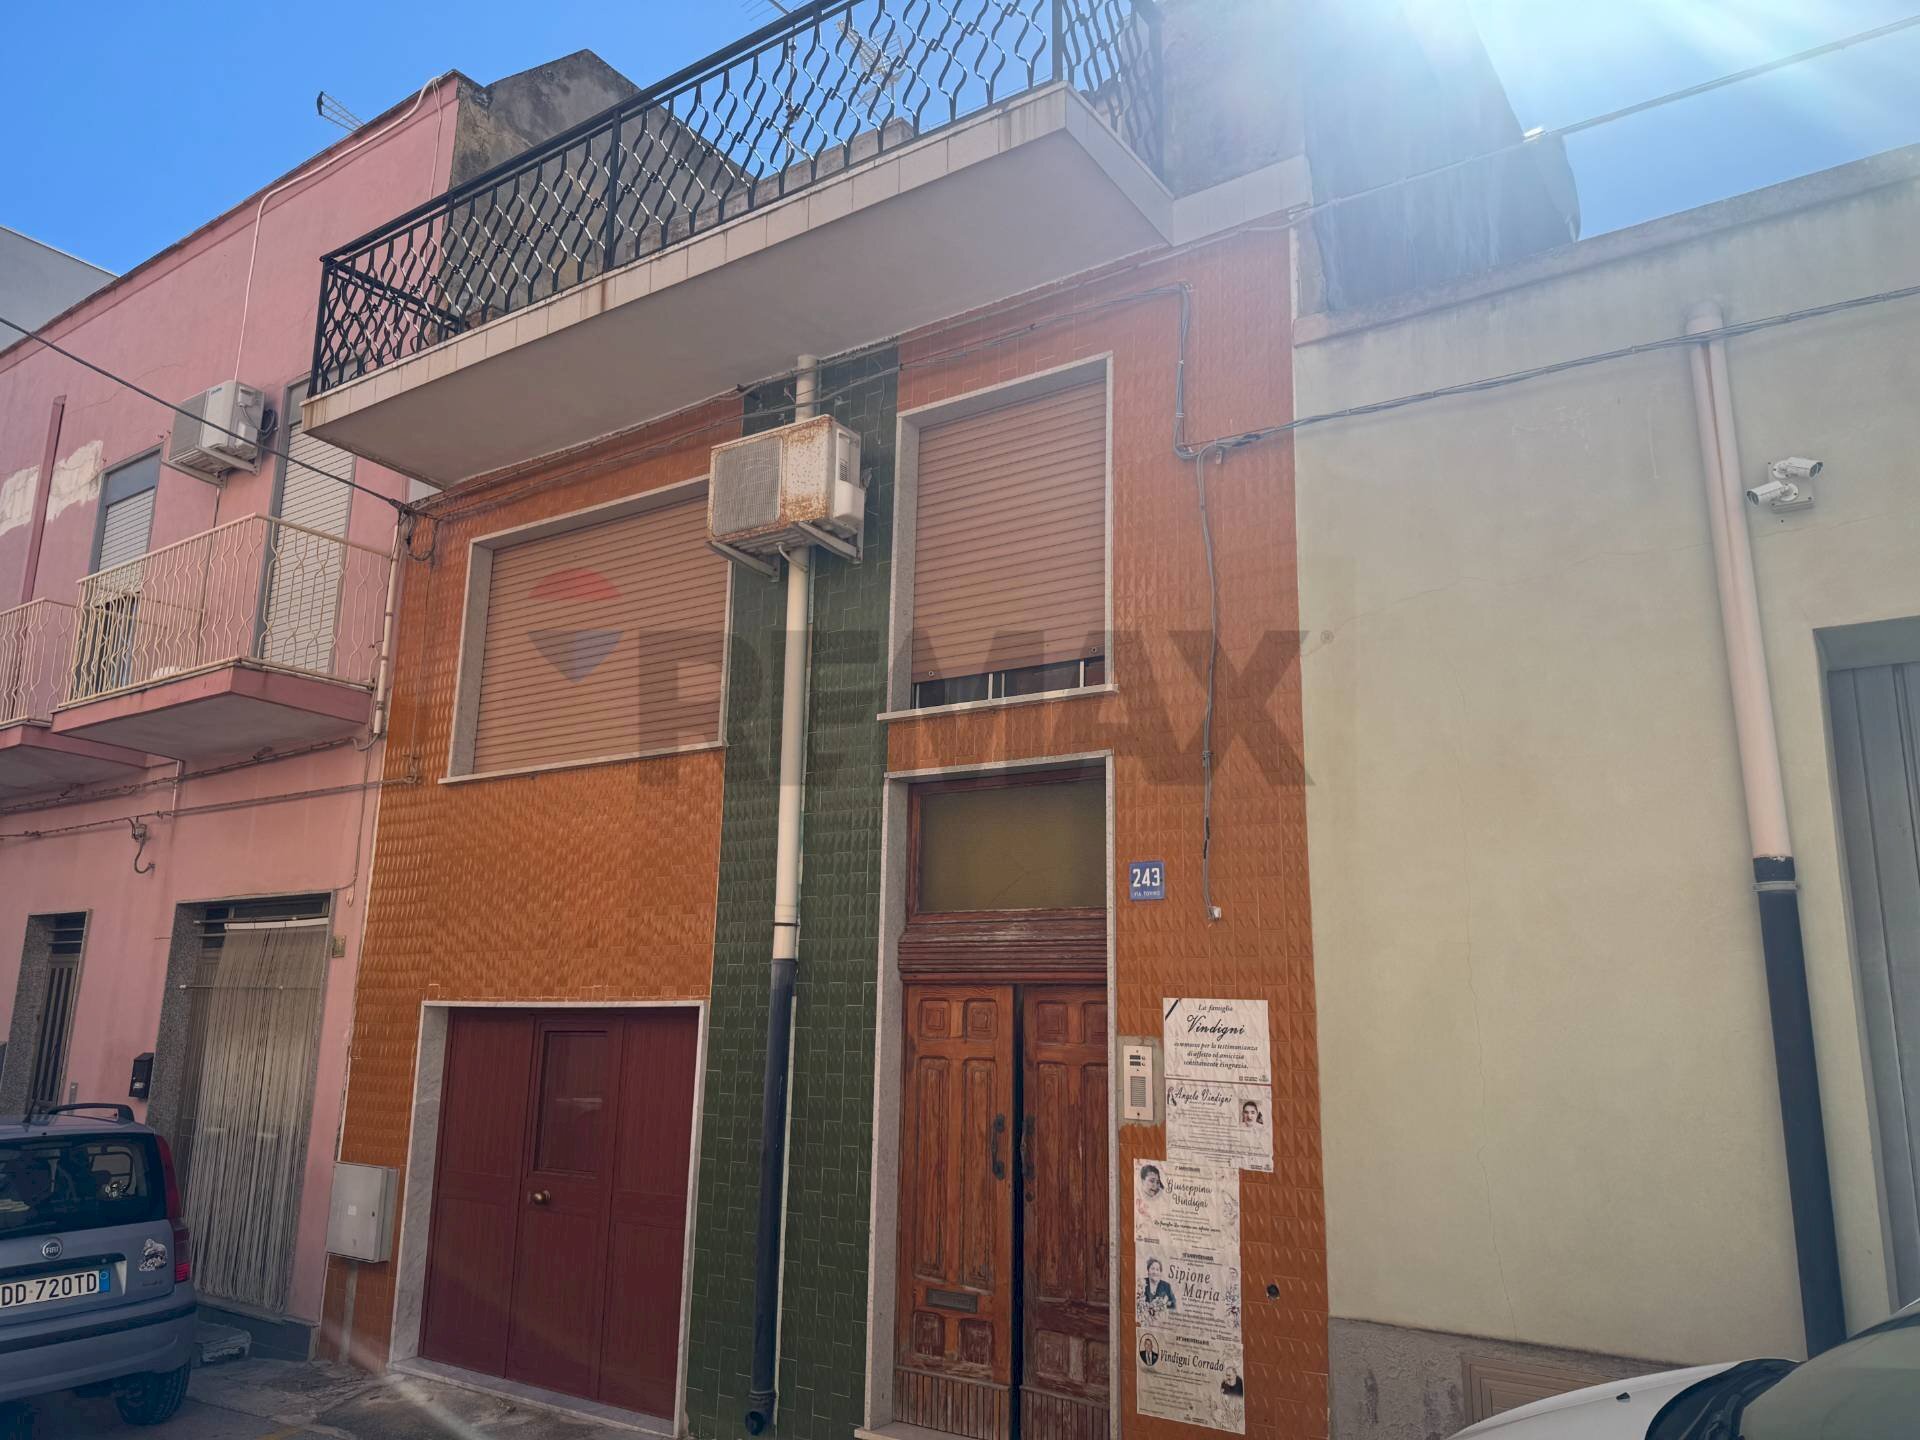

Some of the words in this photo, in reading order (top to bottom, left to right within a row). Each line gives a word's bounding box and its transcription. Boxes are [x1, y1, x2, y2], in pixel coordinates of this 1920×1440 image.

[1132, 867, 1160, 887] 243
[1208, 1004, 1233, 1014] famiglia
[1186, 1014, 1245, 1042] Vindigni
[1174, 1087, 1199, 1104] Angelo
[1201, 1088, 1233, 1107] Vindigni
[1166, 1178, 1213, 1195] Giuseppina
[1172, 1193, 1209, 1211] Vindigni
[1168, 1264, 1211, 1284] Sipione
[1, 1284, 27, 1306] DD
[36, 1273, 97, 1299] 720TD
[1183, 1283, 1220, 1302] Maria
[1160, 1349, 1190, 1367] Vindigni
[1192, 1355, 1224, 1372] Corrado
